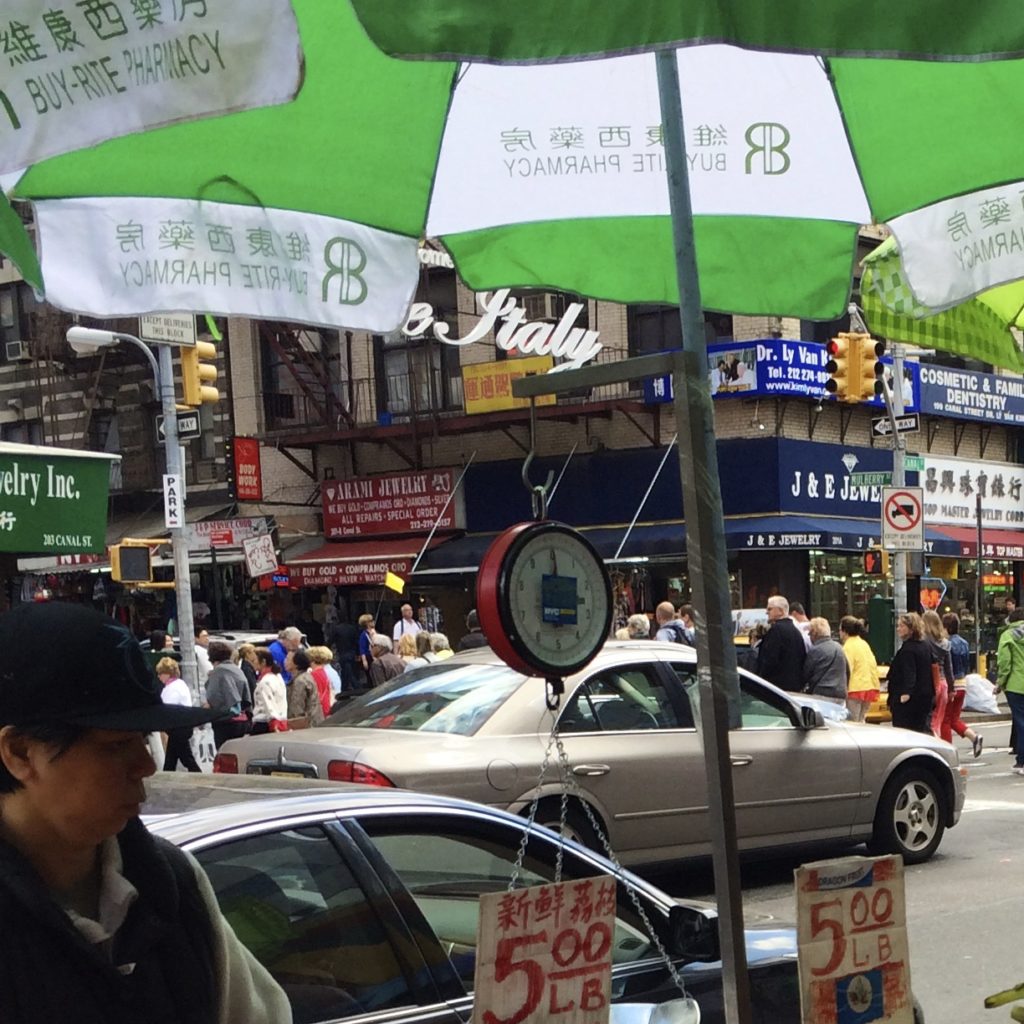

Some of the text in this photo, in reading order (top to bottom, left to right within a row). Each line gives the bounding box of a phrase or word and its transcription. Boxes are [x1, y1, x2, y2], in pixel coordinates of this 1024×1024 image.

[25, 30, 225, 114] BUY-RITE PHARMACY
[757, 345, 778, 361] Dr.
[782, 344, 794, 364] Ly
[798, 346, 818, 366] Van
[768, 367, 800, 379] Tel. 212
[920, 368, 978, 391] COSMETIC
[983, 378, 991, 393] &
[947, 388, 1007, 410] DENTISTRY
[179, 417, 195, 431] WAY
[239, 464, 256, 475] BODY
[47, 465, 80, 499] Inc.
[238, 475, 258, 487] WORK
[337, 475, 427, 500] ARAMI JEWELRY
[791, 471, 801, 498] J
[807, 471, 818, 499] &
[825, 474, 835, 499] E
[851, 474, 885, 486] MULBERRY
[167, 477, 178, 518] PARK
[342, 507, 438, 524] ALL REPAIRS SPECIAL ORDER
[941, 505, 969, 519] MASTER
[56, 535, 82, 547] CANAL
[747, 534, 821, 546] J & E JEWELRY
[302, 566, 316, 576] BUY
[320, 566, 337, 575] GOLD
[345, 562, 389, 575] COMPRAMOS
[818, 874, 849, 887] DRAGON
[852, 934, 892, 968] LB
[549, 977, 606, 1015] LB
